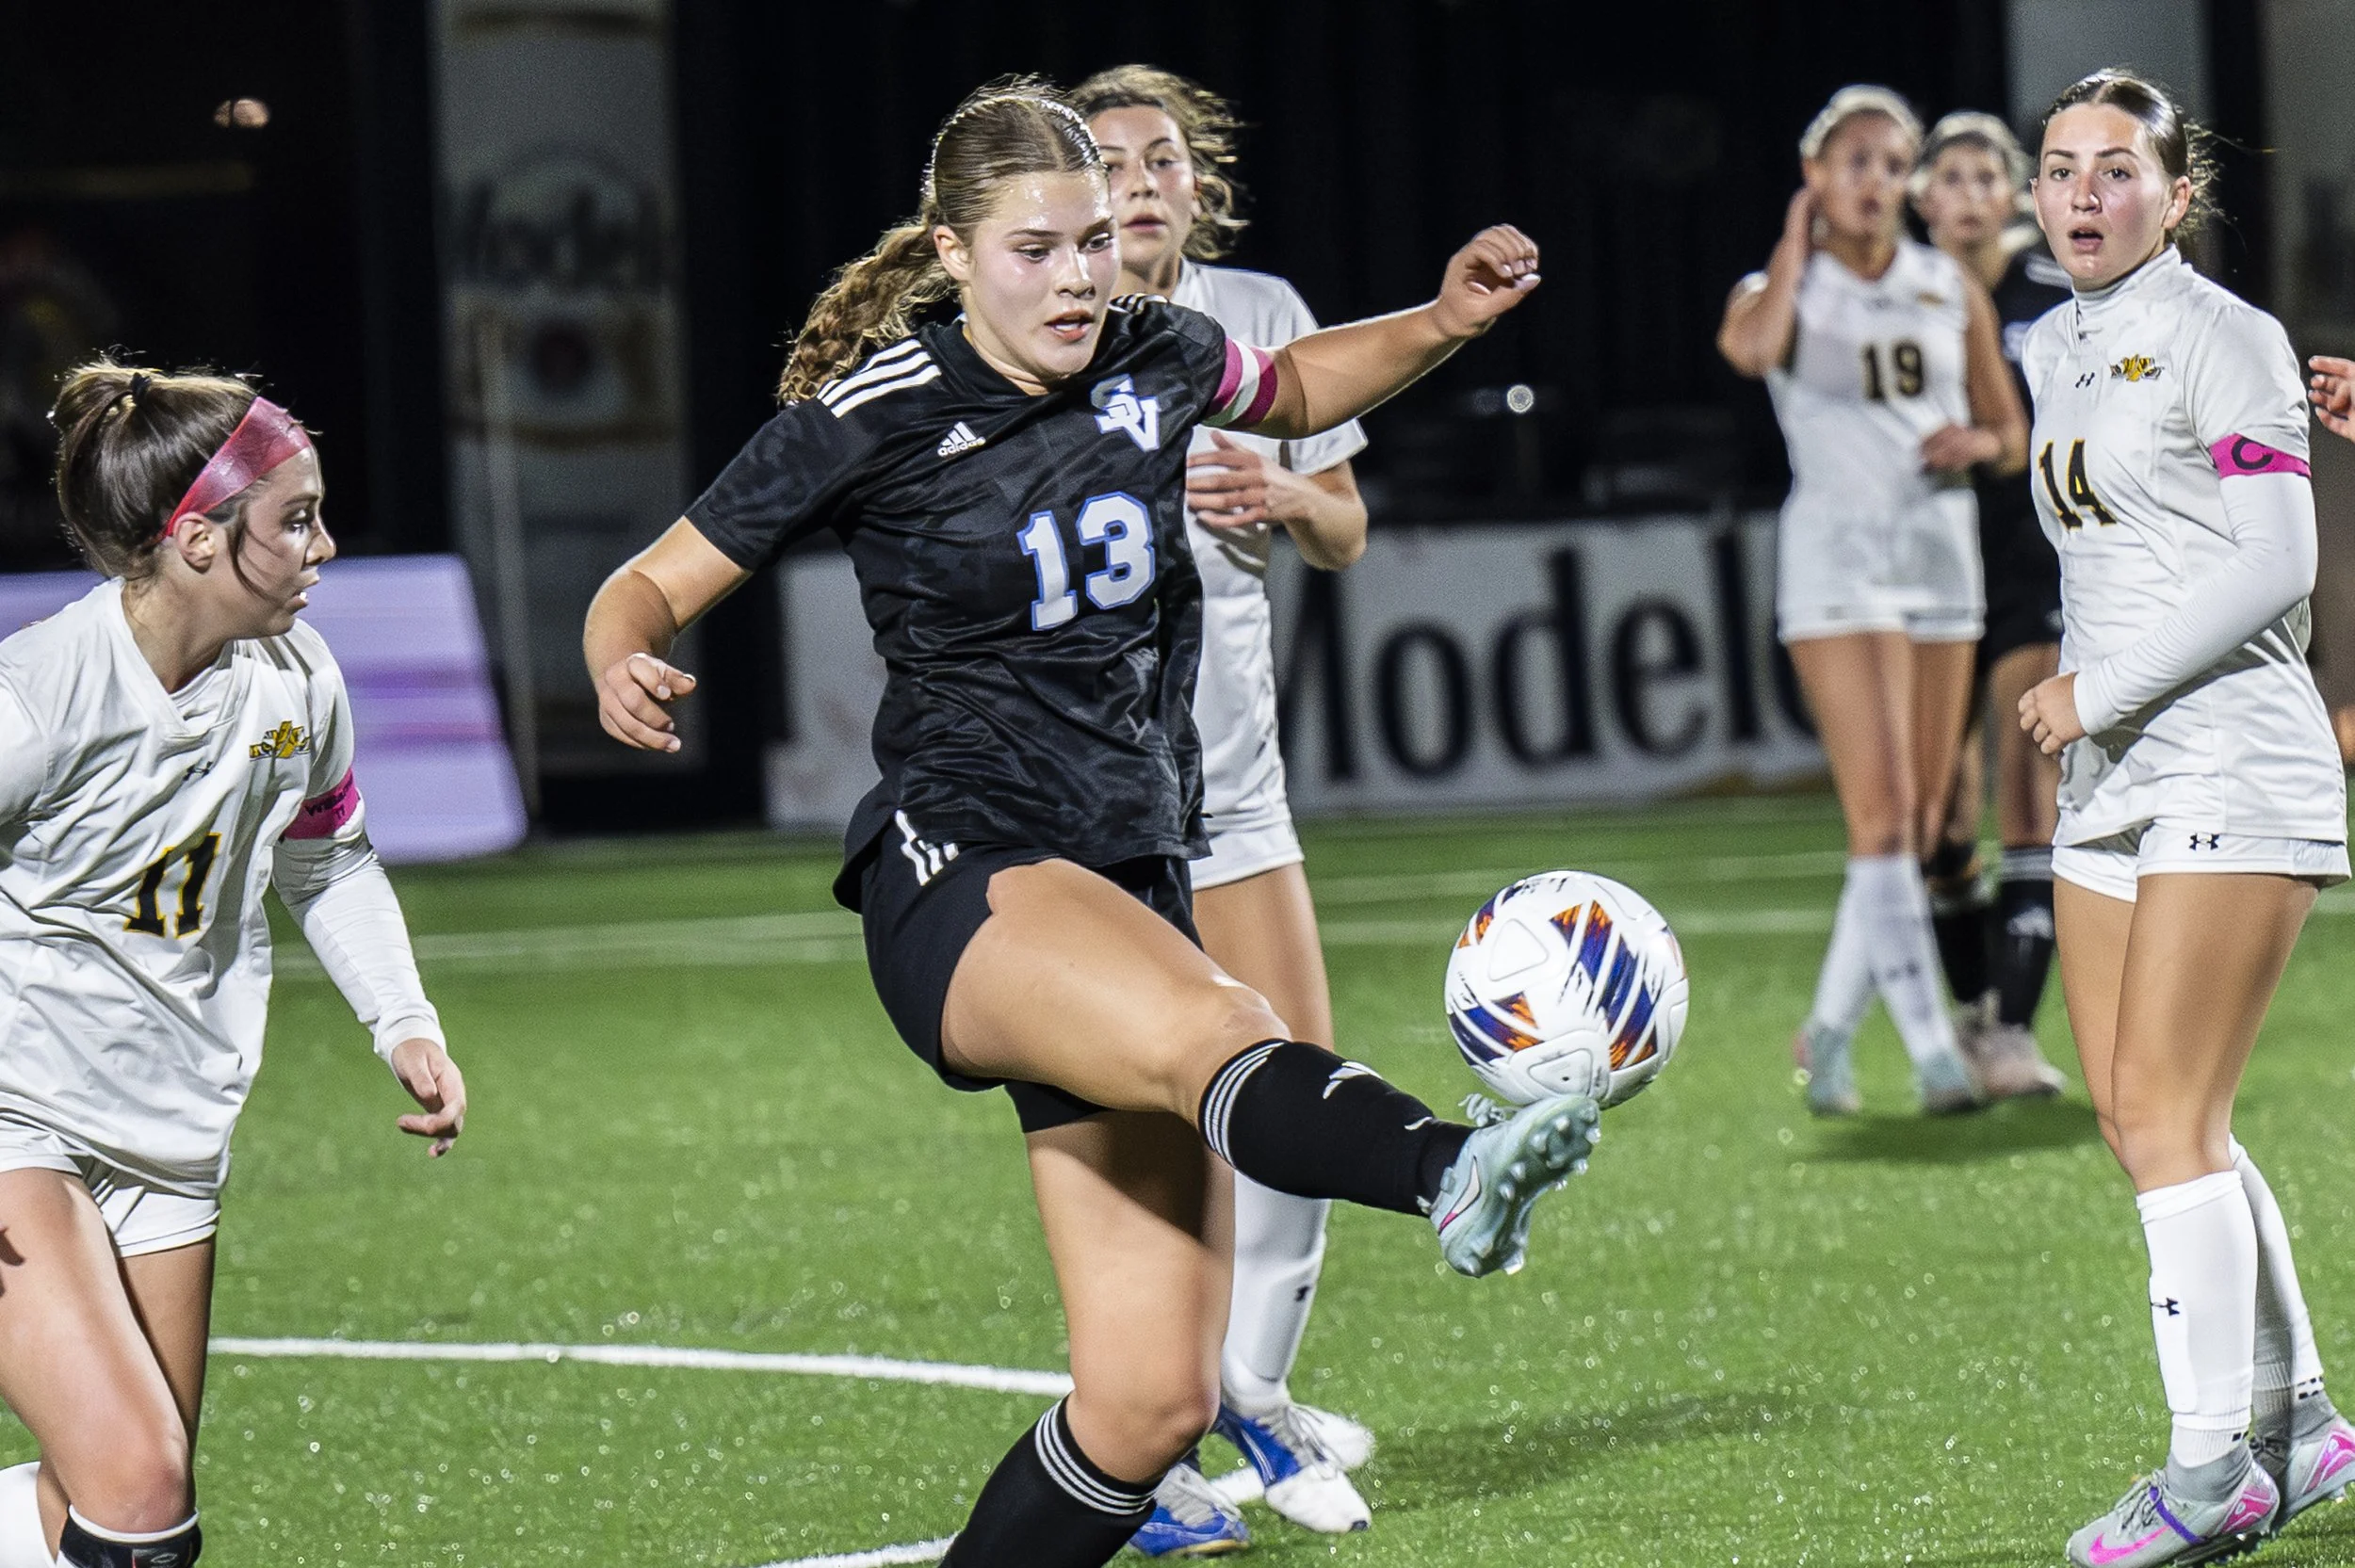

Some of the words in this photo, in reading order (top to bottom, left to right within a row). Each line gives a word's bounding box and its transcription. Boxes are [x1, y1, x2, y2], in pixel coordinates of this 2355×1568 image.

[1862, 339, 1925, 402] 19
[937, 436, 986, 457] adidas
[2038, 438, 2118, 530] 14
[2231, 436, 2275, 470] C
[1016, 491, 1156, 632] 13
[122, 832, 222, 939] 11
